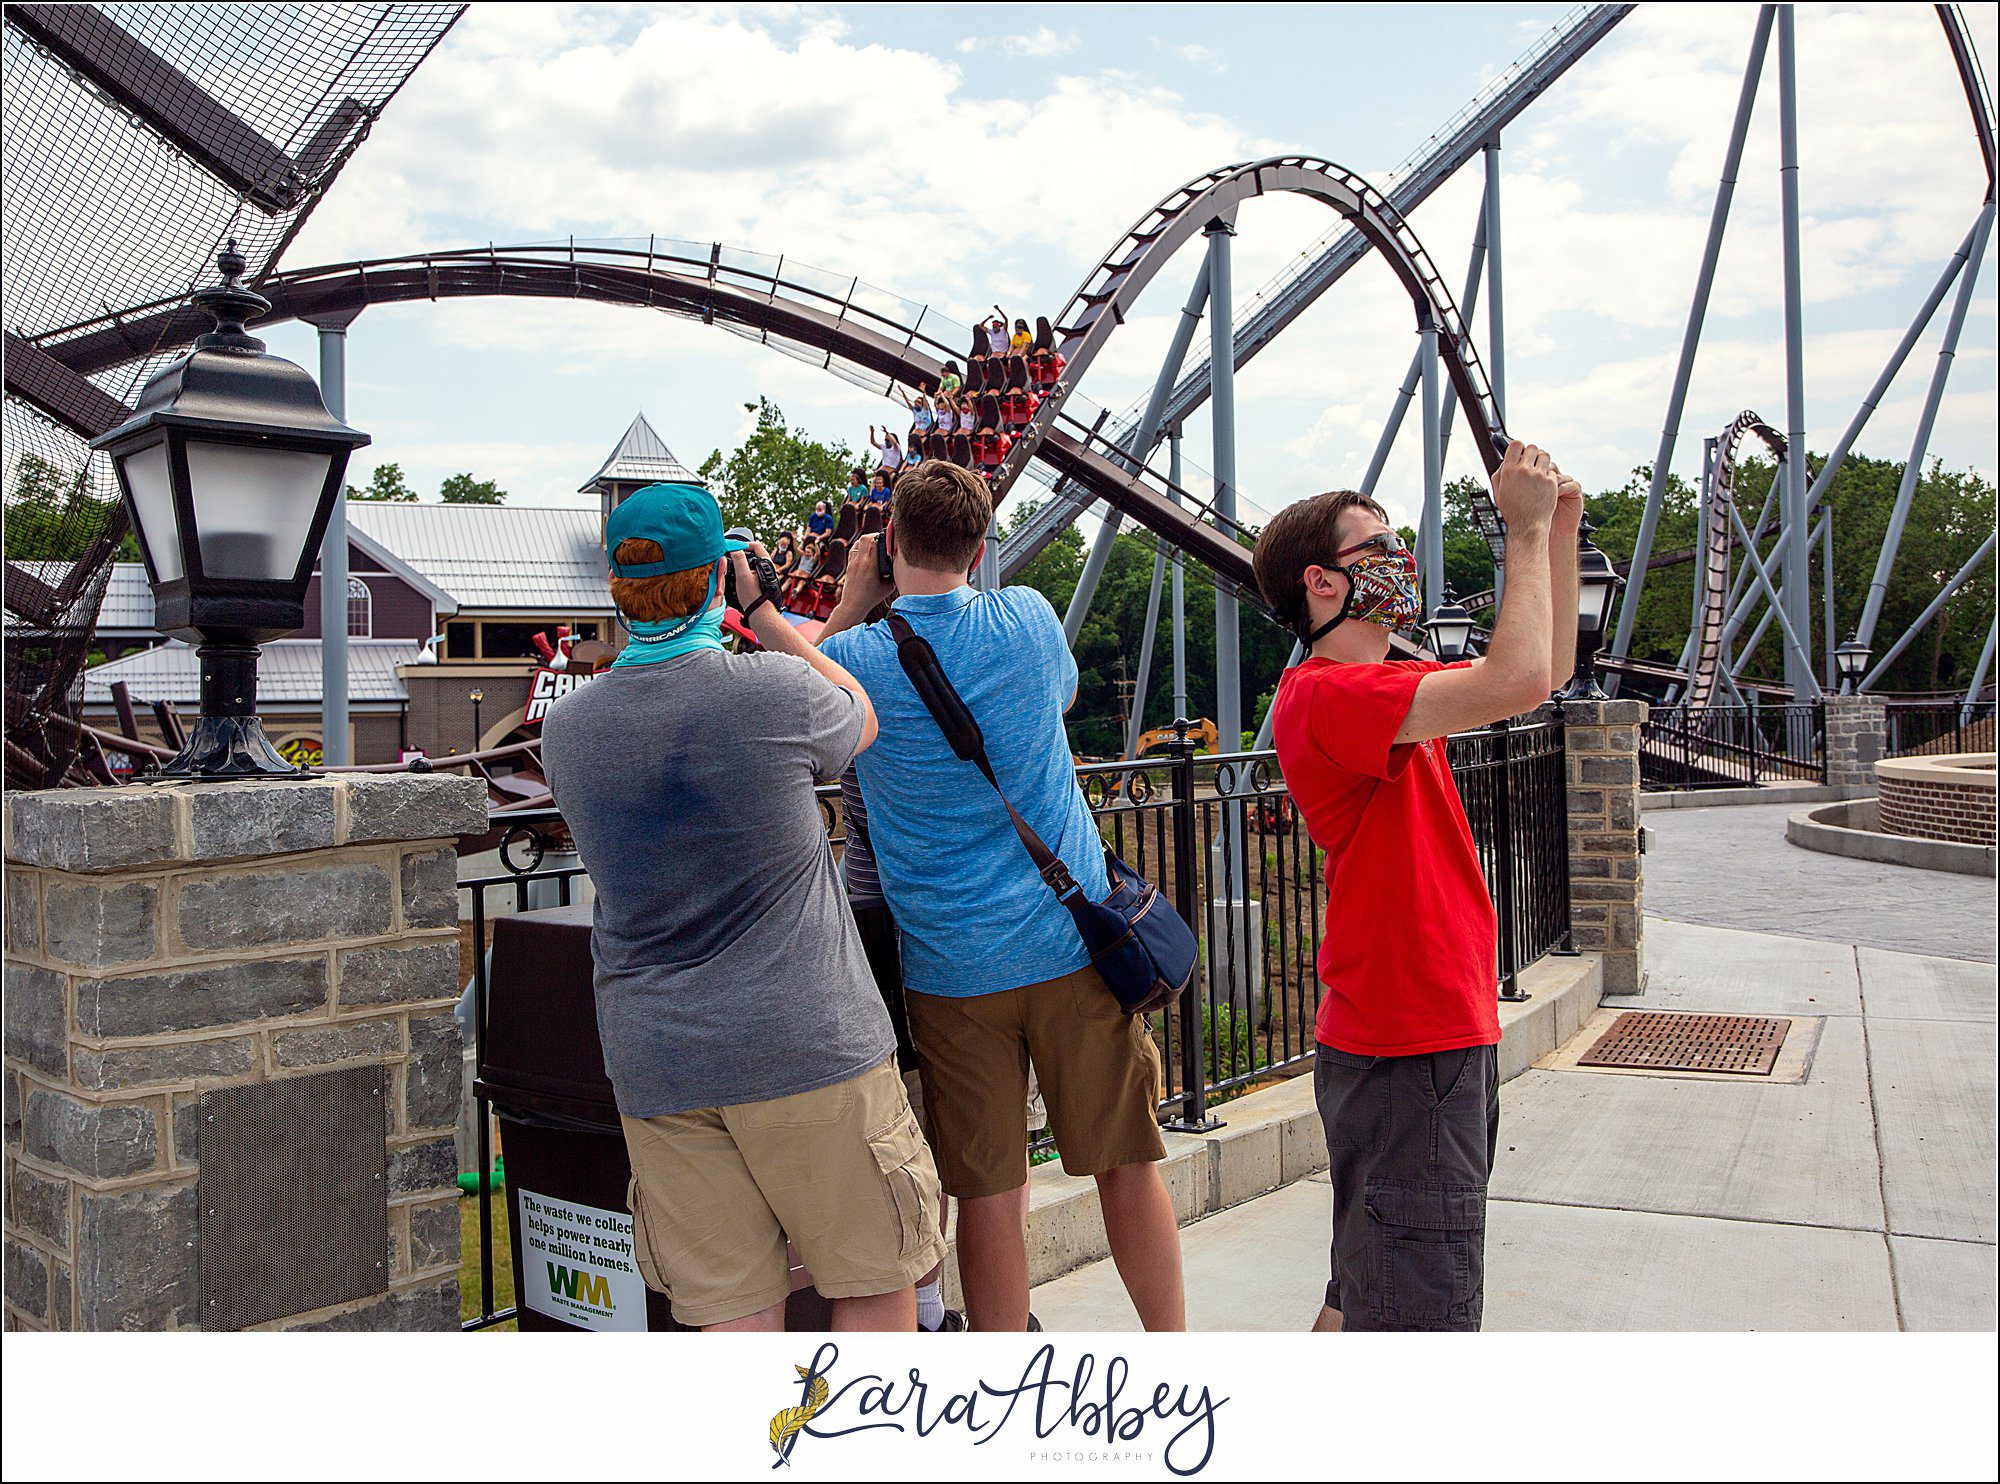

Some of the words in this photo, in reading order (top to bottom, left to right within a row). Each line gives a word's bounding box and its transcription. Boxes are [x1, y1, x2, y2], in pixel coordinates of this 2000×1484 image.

[630, 623, 687, 642] HURRICANE
[532, 670, 610, 699] CAN
[278, 740, 323, 766] Ree
[523, 1196, 542, 1213] The
[543, 1204, 574, 1222] waste
[576, 1213, 592, 1226] we
[528, 1215, 555, 1236] helps
[556, 1226, 591, 1245] power
[593, 1234, 632, 1257] nearly
[529, 1236, 547, 1250] one
[548, 1243, 587, 1262] million
[588, 1251, 634, 1273] homes.
[546, 1260, 613, 1309] WM
[551, 1296, 570, 1306] WASTE
[570, 1302, 614, 1319] MANAGEMENT
